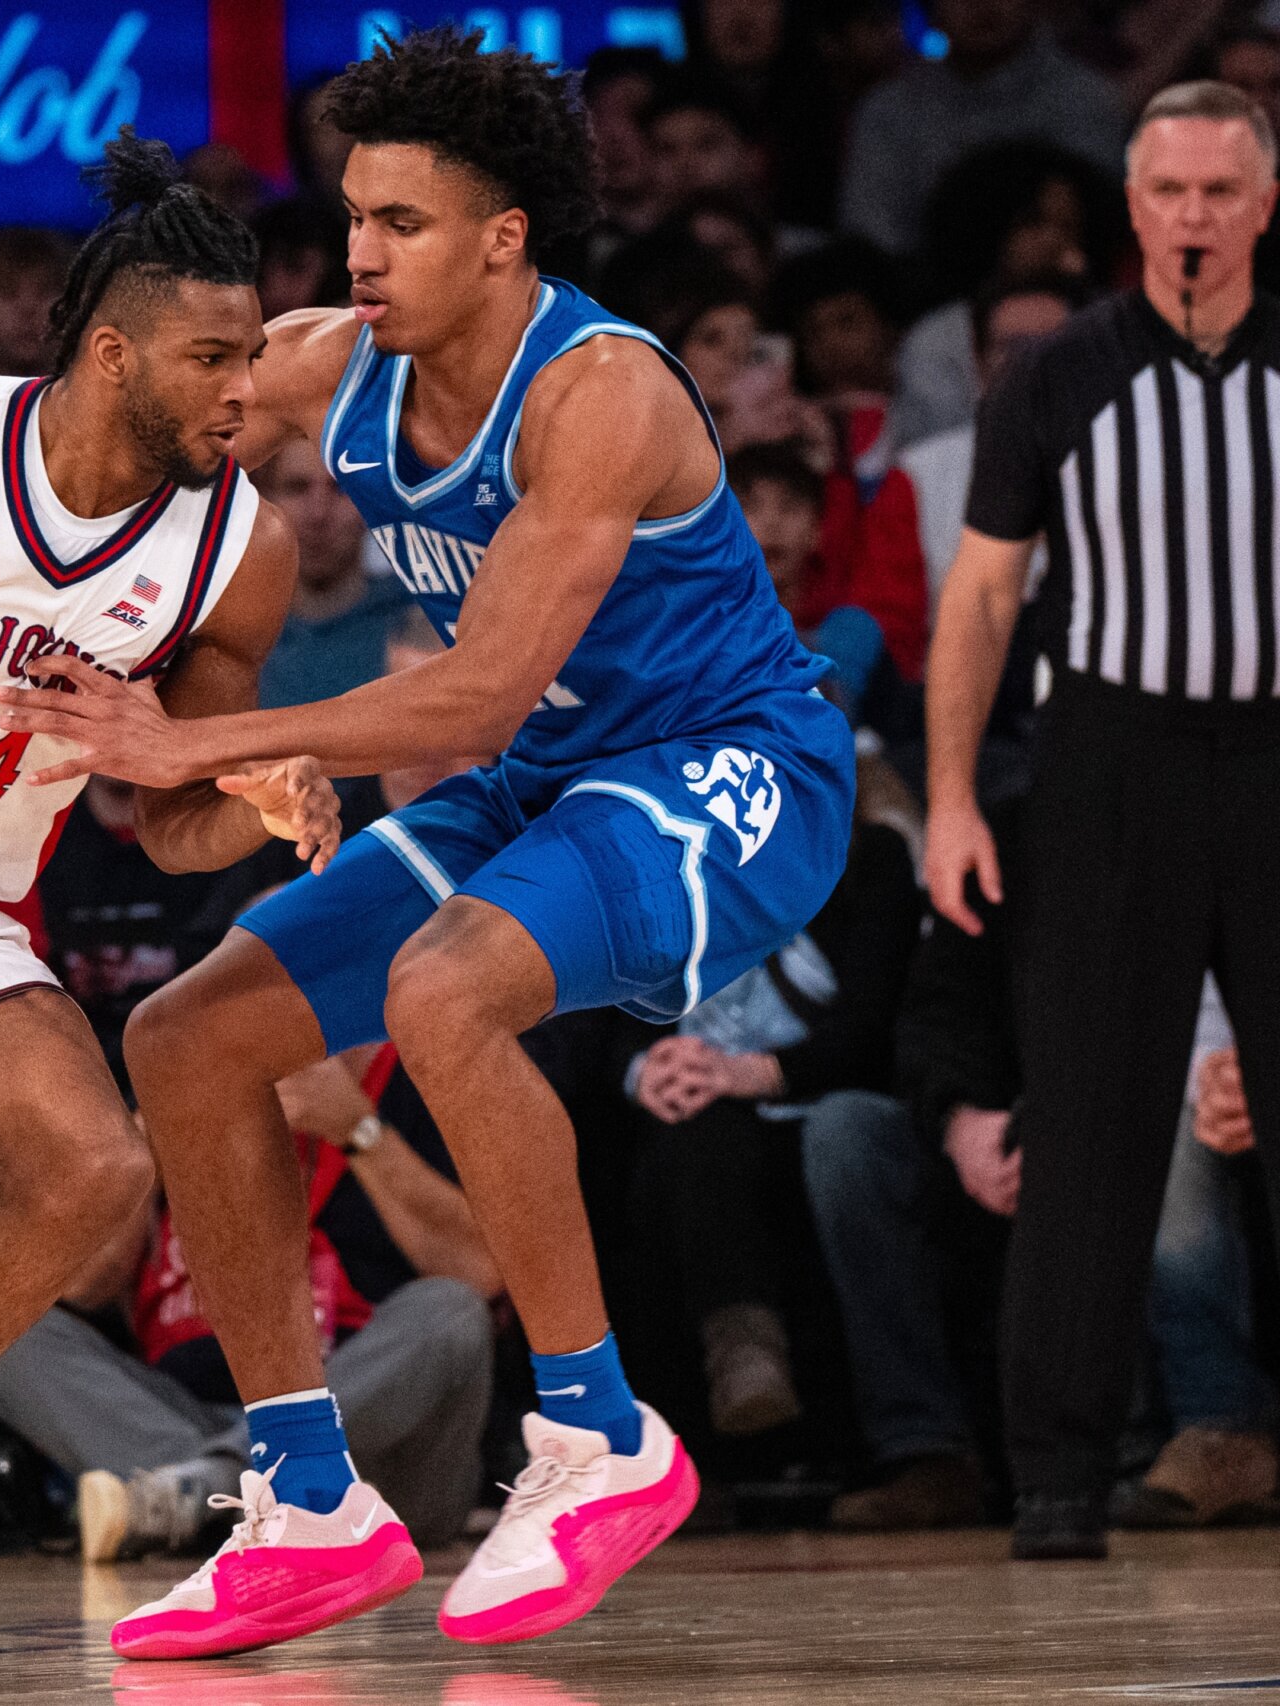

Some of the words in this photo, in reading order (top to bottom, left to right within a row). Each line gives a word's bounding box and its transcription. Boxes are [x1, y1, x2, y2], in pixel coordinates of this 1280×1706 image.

[475, 493, 497, 503] EAST
[371, 521, 488, 596] XAVI
[107, 607, 148, 627] EAST
[116, 600, 145, 617] BIG
